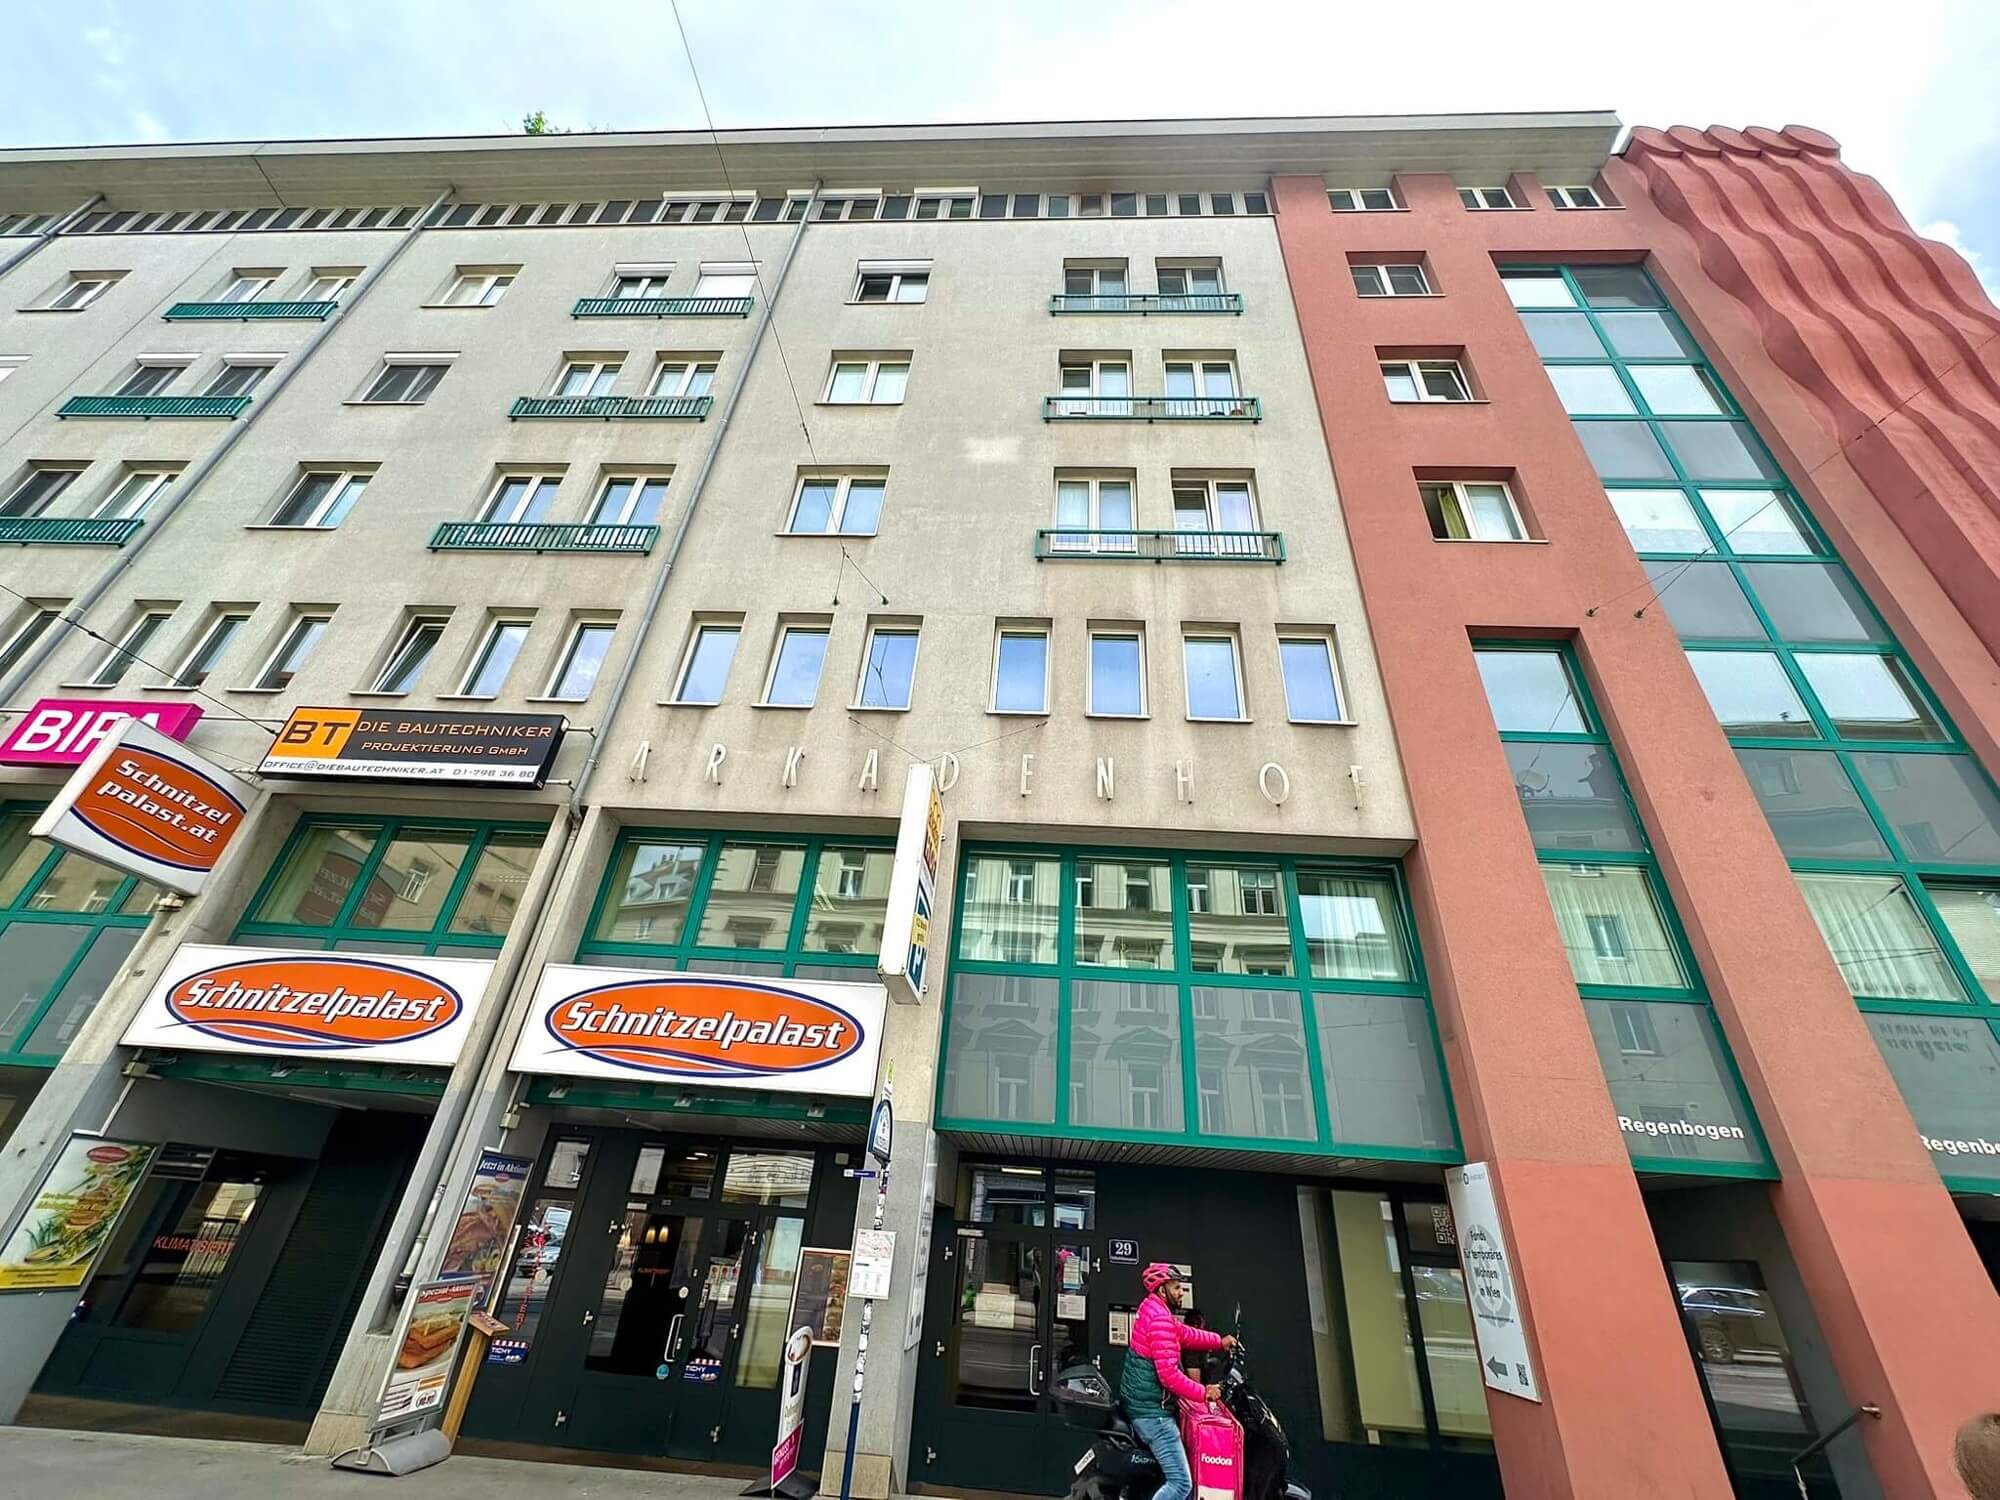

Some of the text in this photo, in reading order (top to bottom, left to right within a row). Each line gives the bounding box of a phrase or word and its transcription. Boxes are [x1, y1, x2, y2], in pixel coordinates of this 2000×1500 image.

[281, 720, 352, 745] BT
[357, 720, 552, 738] DIE BAUTECHNIKER
[361, 741, 485, 755] PROJEKTIERUNG
[518, 770, 535, 778] 80
[628, 740, 1367, 808] ARKADENHOF
[115, 758, 233, 826] Schnitzel
[96, 780, 219, 844] palast.at
[179, 979, 446, 1023] Schnitzelpalast
[560, 1001, 847, 1050] Schnitzelpalast
[1617, 1115, 1745, 1140] Regenbogen
[1115, 1242, 1132, 1256] 29
[685, 1364, 707, 1372] TICHY
